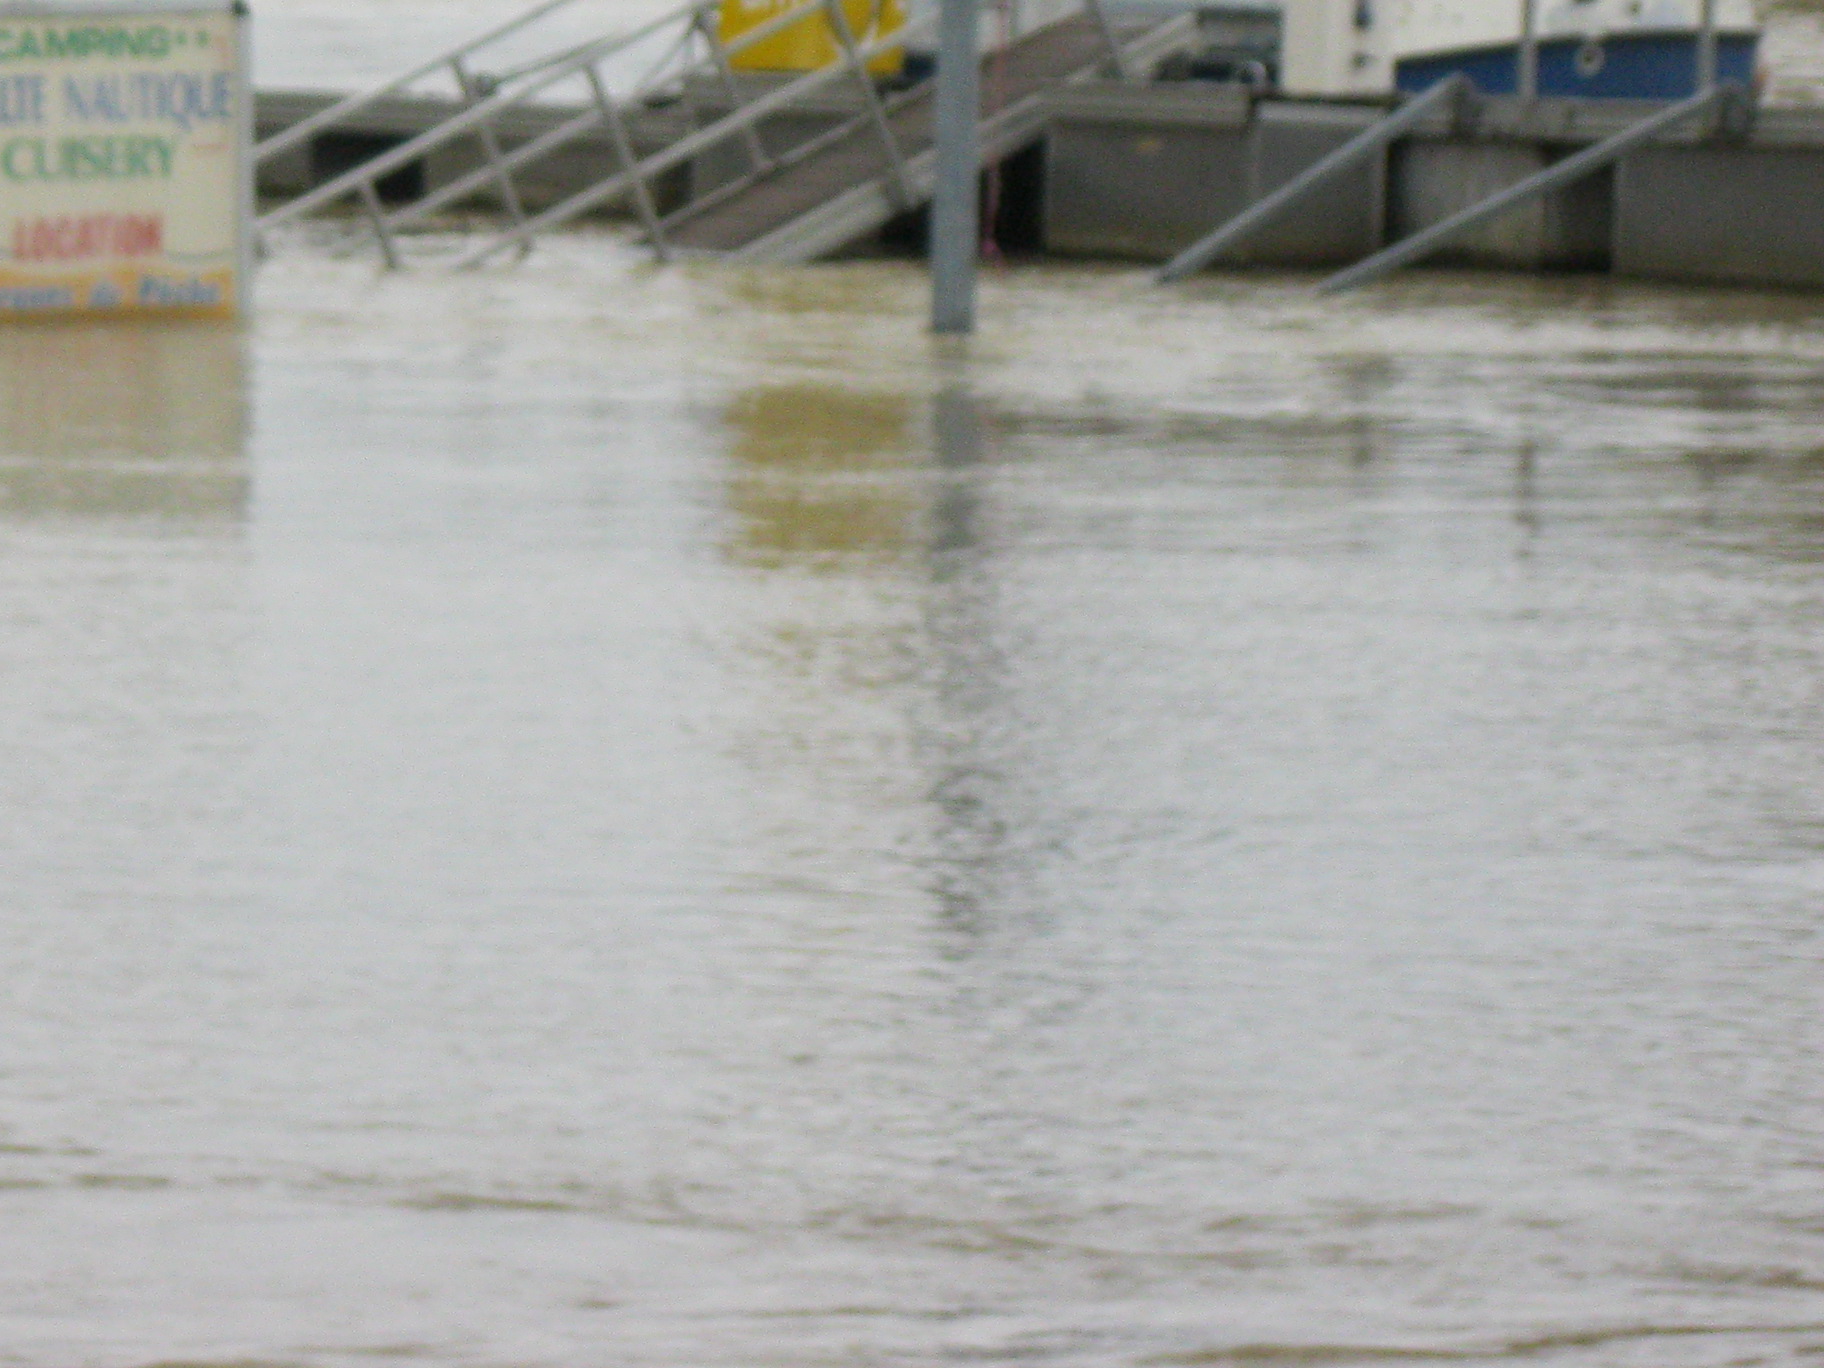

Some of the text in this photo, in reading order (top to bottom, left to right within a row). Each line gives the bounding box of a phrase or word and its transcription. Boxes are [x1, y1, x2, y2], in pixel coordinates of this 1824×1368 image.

[63, 70, 233, 131] NAUTIQUE
[0, 136, 174, 182] CUISERY
[12, 212, 164, 262] LOCATION
